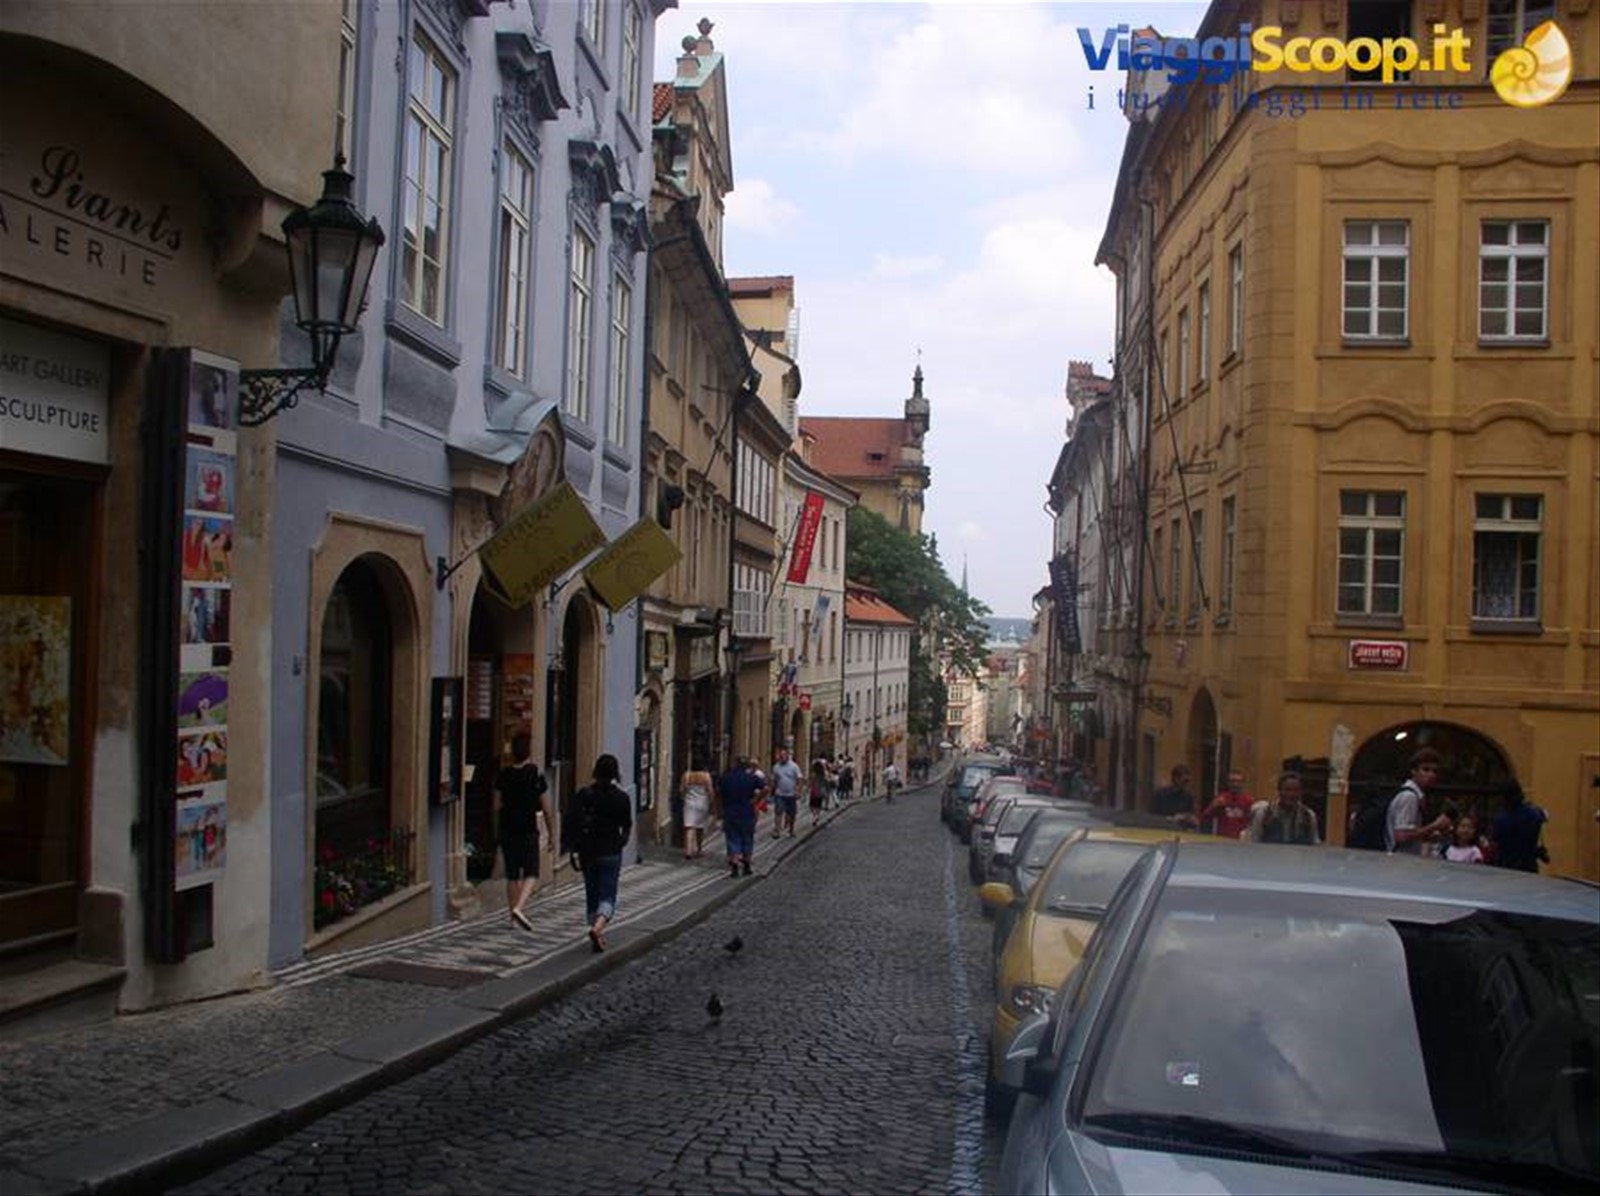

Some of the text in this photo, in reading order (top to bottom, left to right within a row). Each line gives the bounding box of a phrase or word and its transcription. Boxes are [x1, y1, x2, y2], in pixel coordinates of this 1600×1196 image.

[0, 353, 103, 388] ART GALLERY
[0, 396, 99, 432] SCULPTURE
